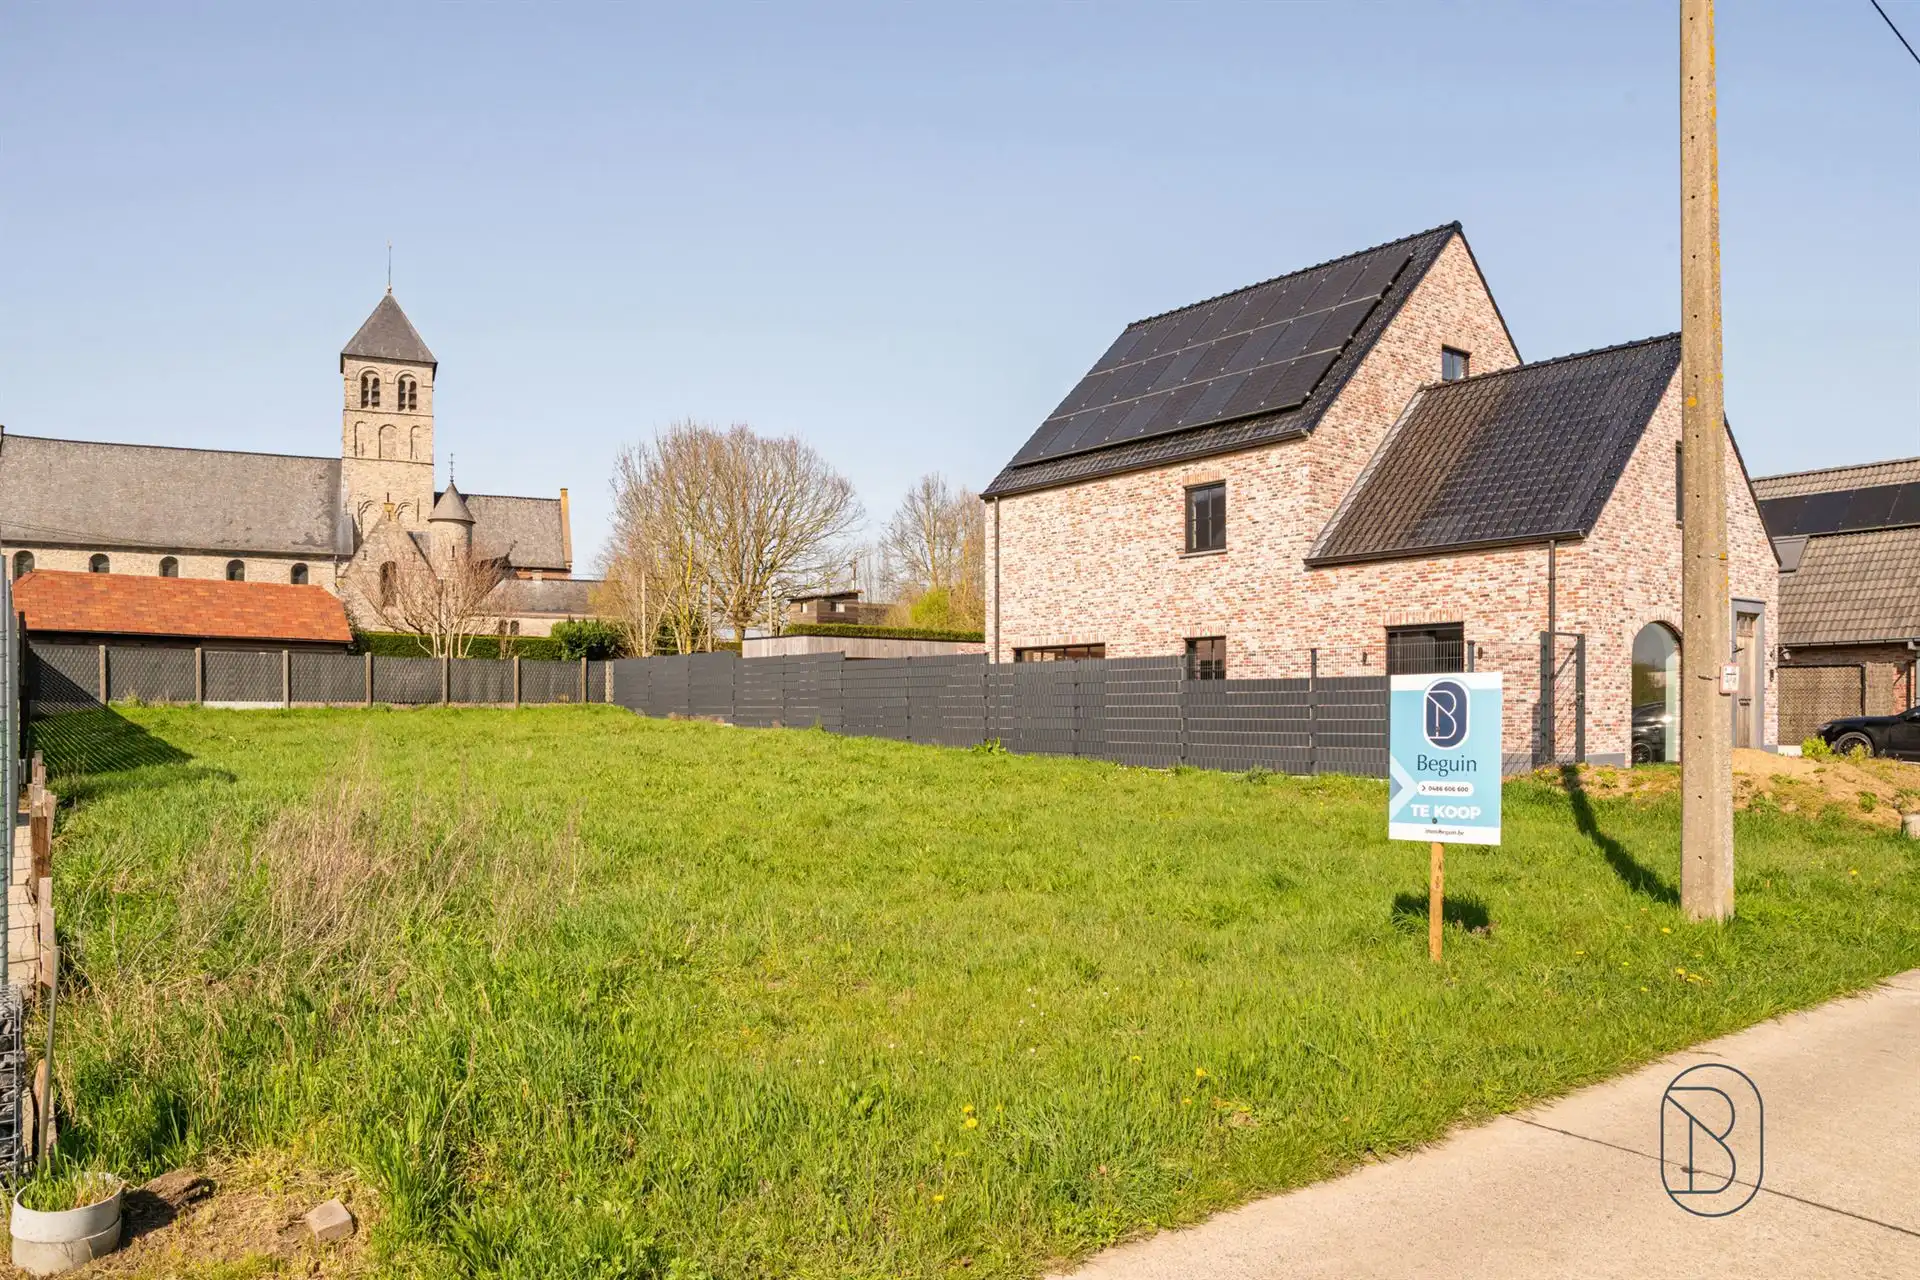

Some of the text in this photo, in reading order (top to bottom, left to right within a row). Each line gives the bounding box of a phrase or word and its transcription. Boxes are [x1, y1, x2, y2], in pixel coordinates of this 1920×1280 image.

[1417, 754, 1477, 777] Beguin
[1457, 785, 1469, 793] 600
[1410, 804, 1482, 819] TE KOOP
